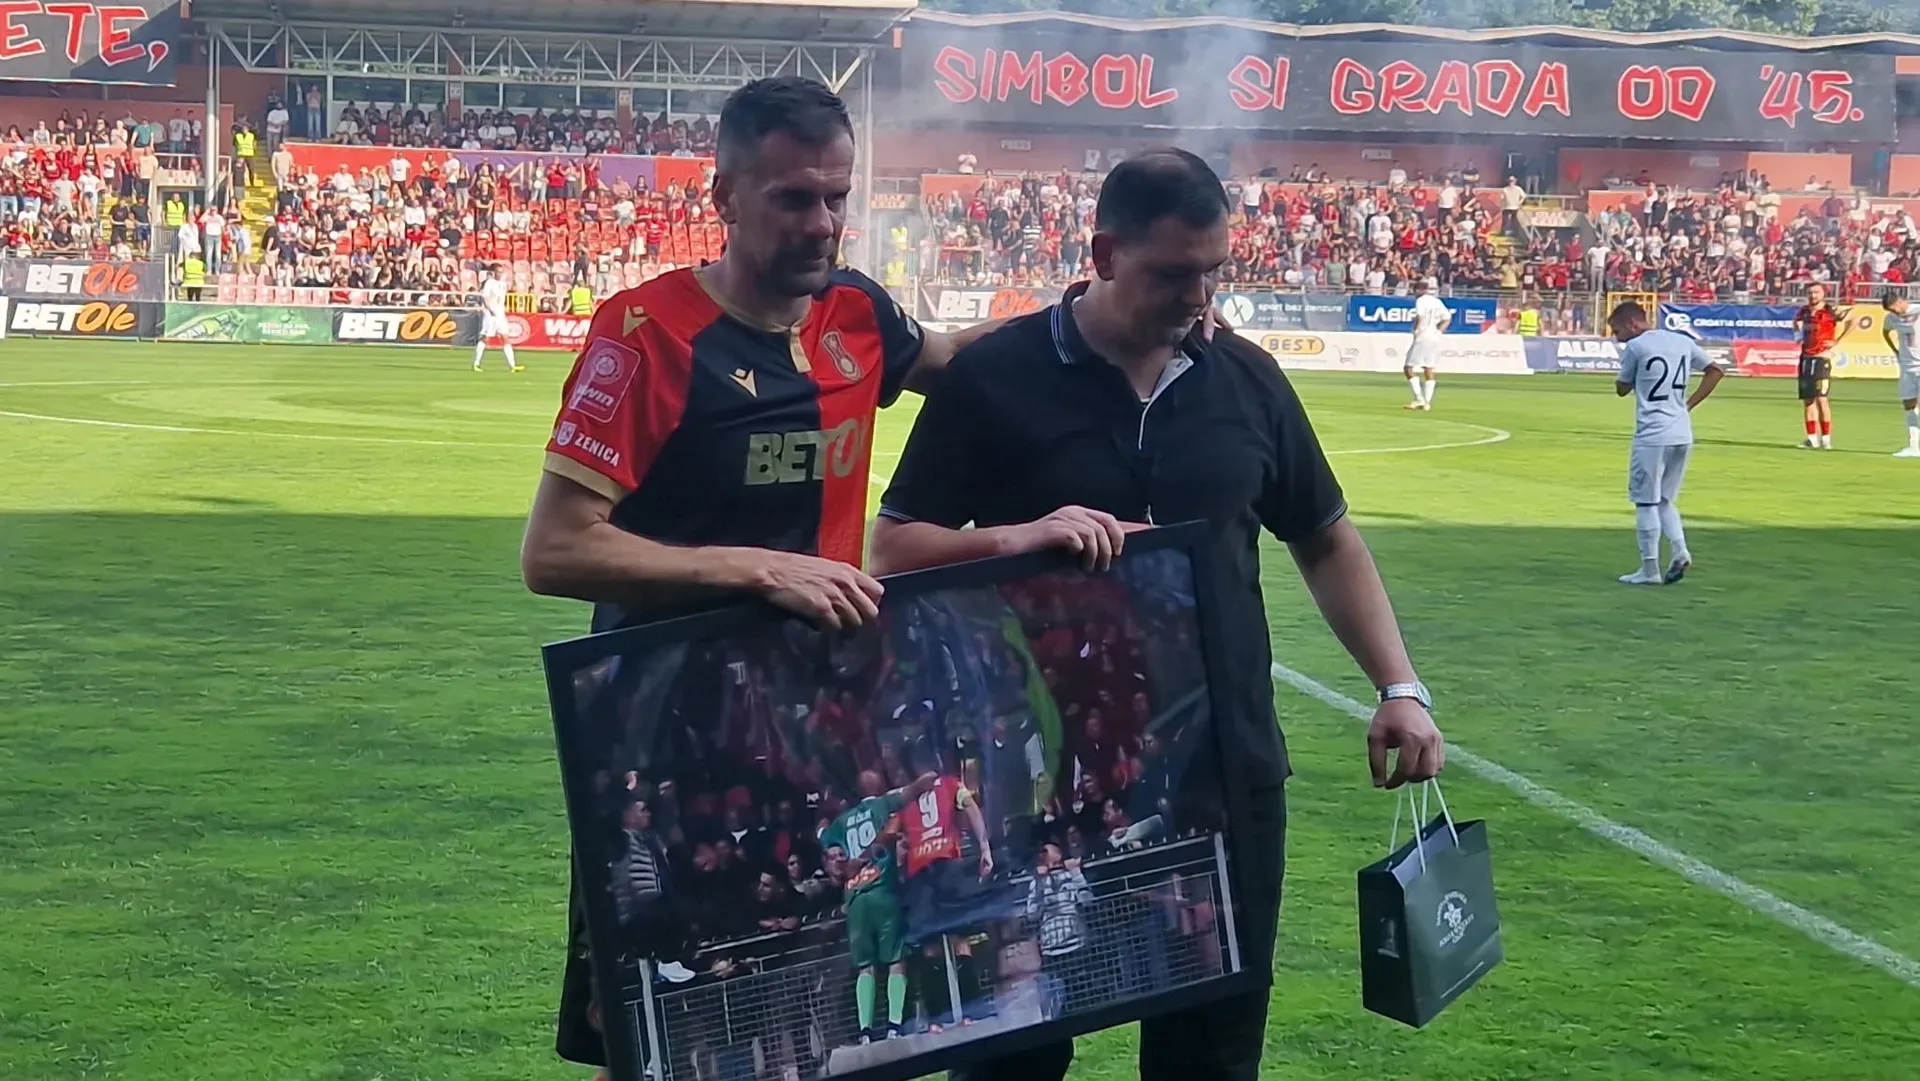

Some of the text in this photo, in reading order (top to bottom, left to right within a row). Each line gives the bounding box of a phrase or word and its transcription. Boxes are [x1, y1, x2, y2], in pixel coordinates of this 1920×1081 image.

[934, 45, 1865, 128] SIMBOL SI GRADA OD '45.
[25, 262, 138, 296] BETOle
[11, 302, 136, 332] BETOle
[338, 310, 457, 340] BETOle
[1269, 338, 1317, 351] BEST
[1645, 355, 1687, 402] 24
[574, 433, 621, 467] ZENICA
[918, 790, 939, 829] 9
